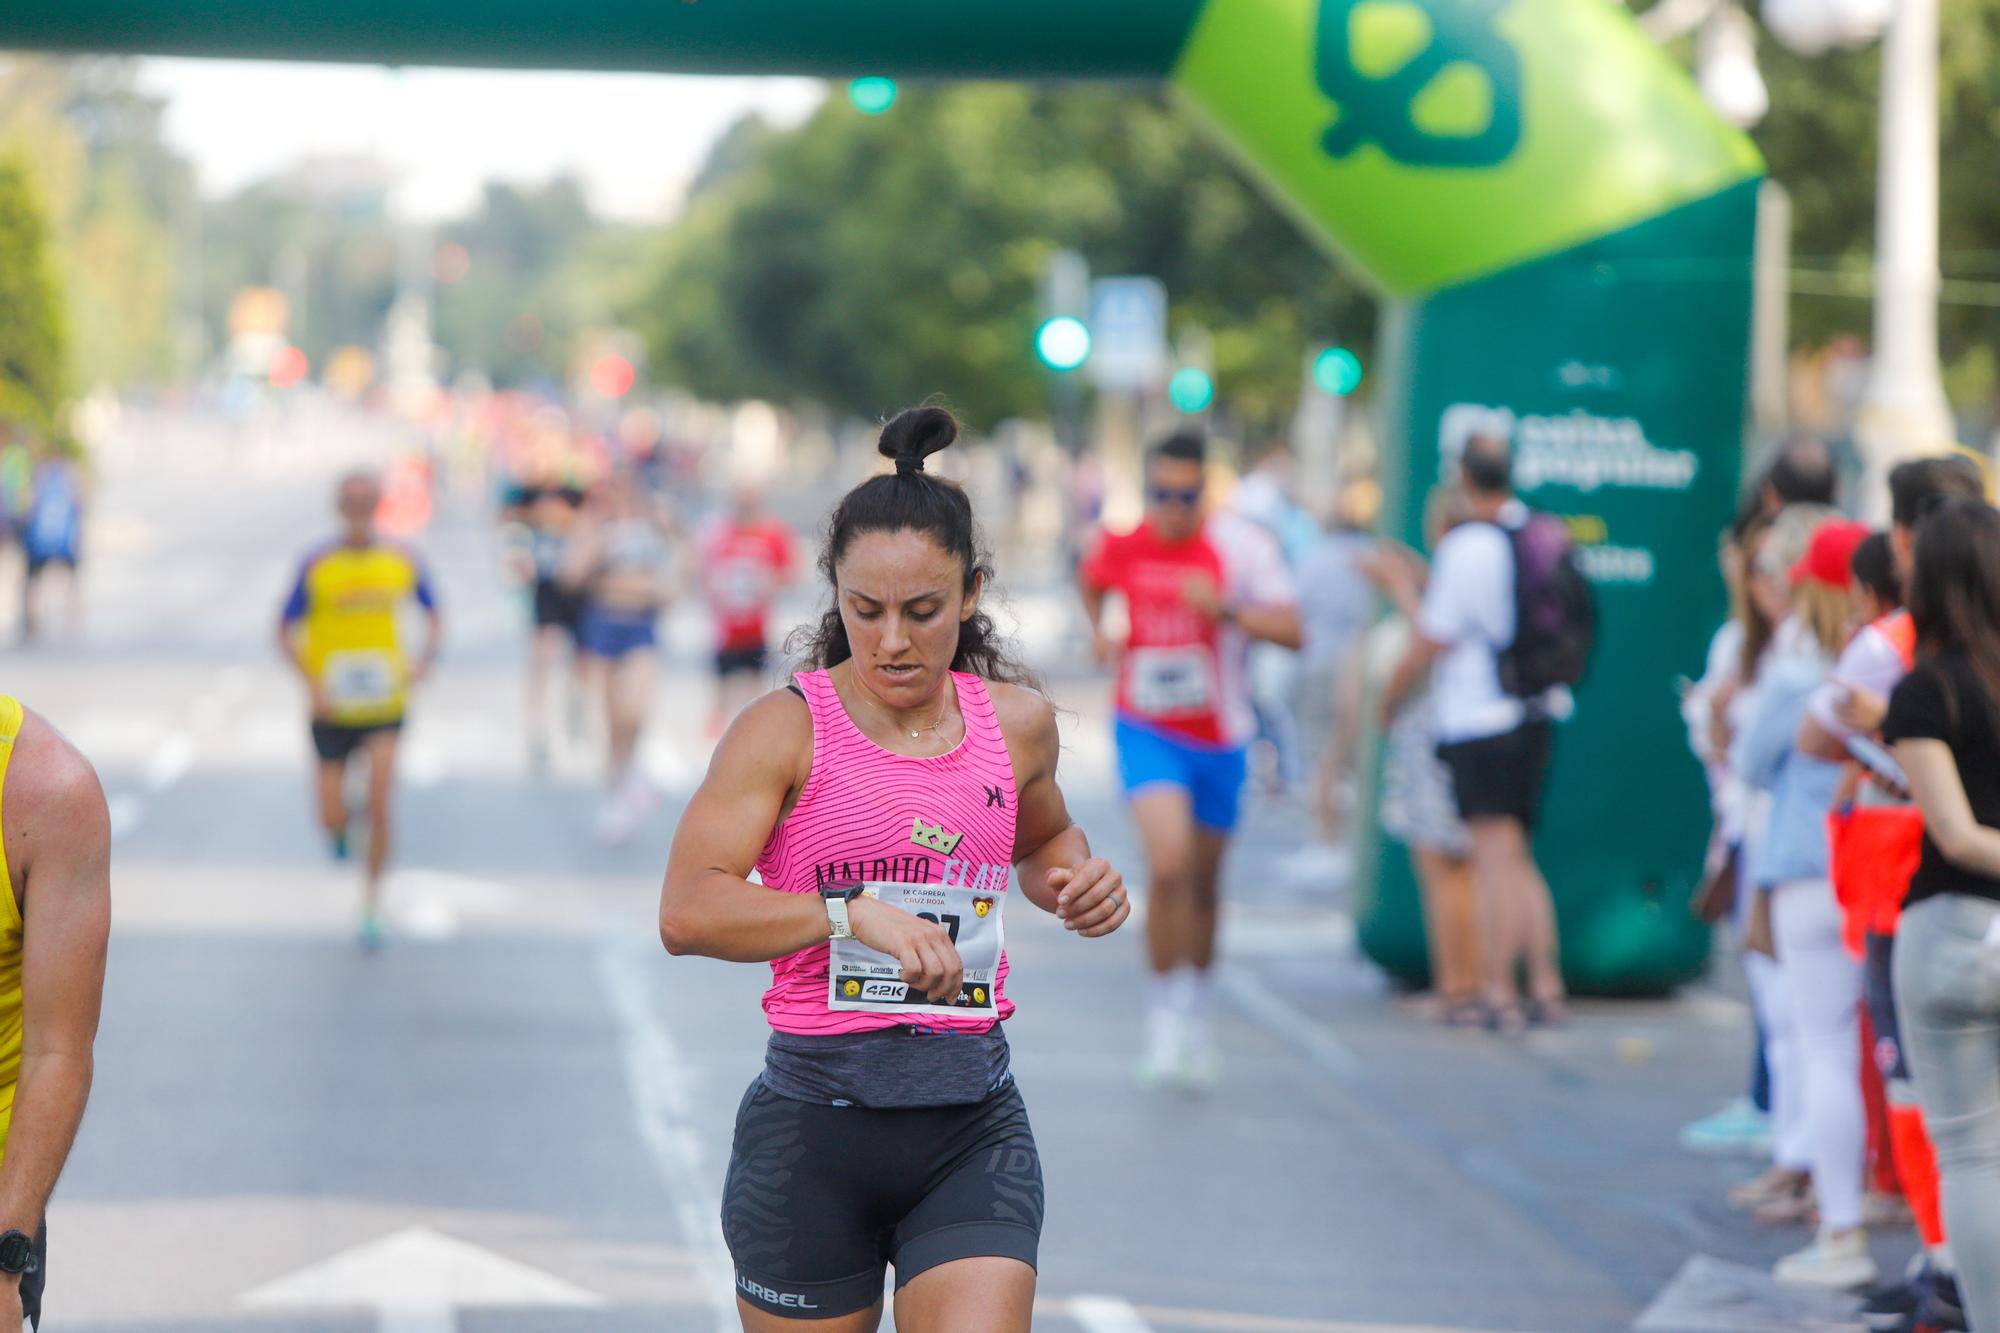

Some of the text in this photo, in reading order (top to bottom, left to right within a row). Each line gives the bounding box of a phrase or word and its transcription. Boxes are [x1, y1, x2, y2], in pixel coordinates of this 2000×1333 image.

[912, 889, 946, 897] CARRERA
[904, 897, 926, 905] CRUZ
[865, 984, 905, 997] 42K
